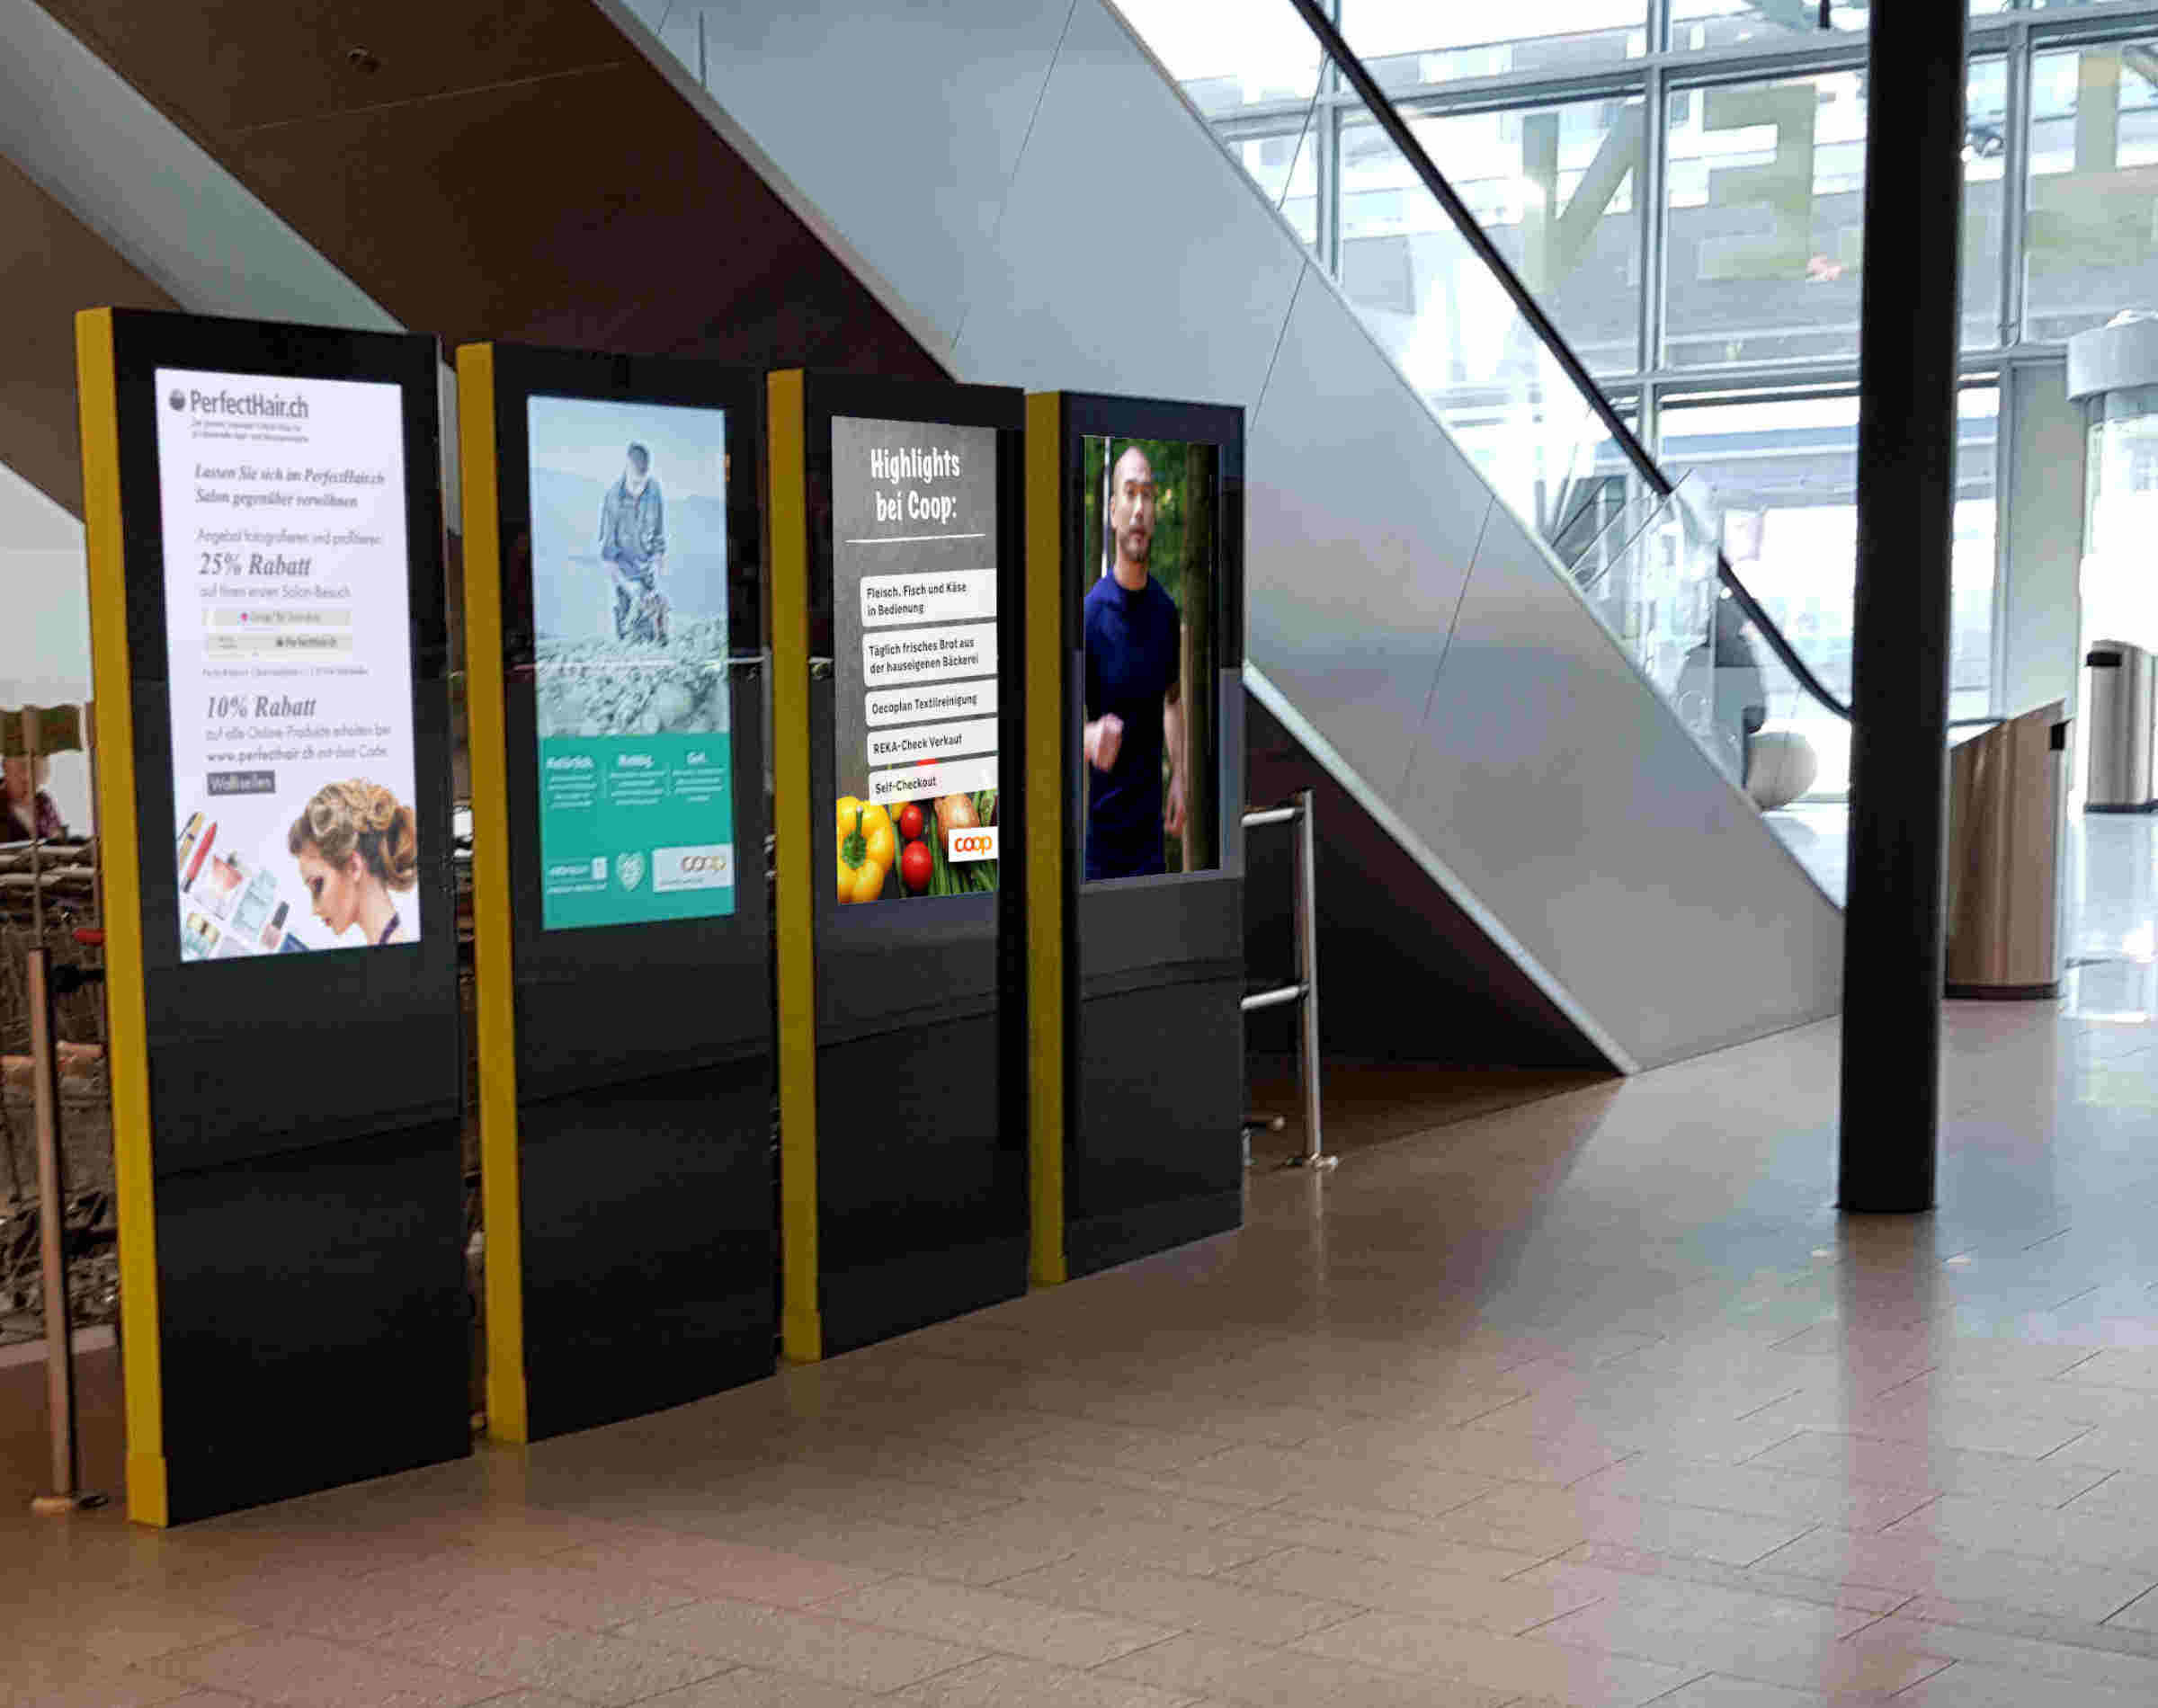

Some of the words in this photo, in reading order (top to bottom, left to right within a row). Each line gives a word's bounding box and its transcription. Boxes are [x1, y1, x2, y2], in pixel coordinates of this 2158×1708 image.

[190, 389, 310, 418] PerfectHair.ch
[260, 467, 283, 482] sich
[870, 447, 960, 485] Highlights
[194, 487, 230, 504] Salon
[876, 491, 903, 521] bei
[907, 490, 958, 525] Coop:
[198, 552, 242, 576] 25%
[247, 552, 312, 576] Rabatt
[903, 583, 927, 598] Fisch
[928, 583, 944, 595] und
[946, 582, 967, 593] Käse
[867, 604, 877, 617] in
[878, 603, 924, 616] Bedienung
[869, 643, 901, 659] Täglich
[902, 639, 938, 654] frisches
[939, 637, 958, 651] Brot
[959, 637, 975, 648] aus
[869, 663, 885, 675] der
[887, 658, 941, 673] hauseigenen
[942, 654, 979, 668] Bäckerei
[208, 695, 247, 719] 10%
[254, 694, 317, 718] Rabatt
[871, 697, 913, 715] Oecoplan
[914, 694, 977, 711] Textilreinigung
[873, 737, 928, 755] REKA-Check
[929, 734, 963, 748] Verkauf
[875, 776, 937, 795] Self-Checkout
[954, 835, 993, 856] coop
